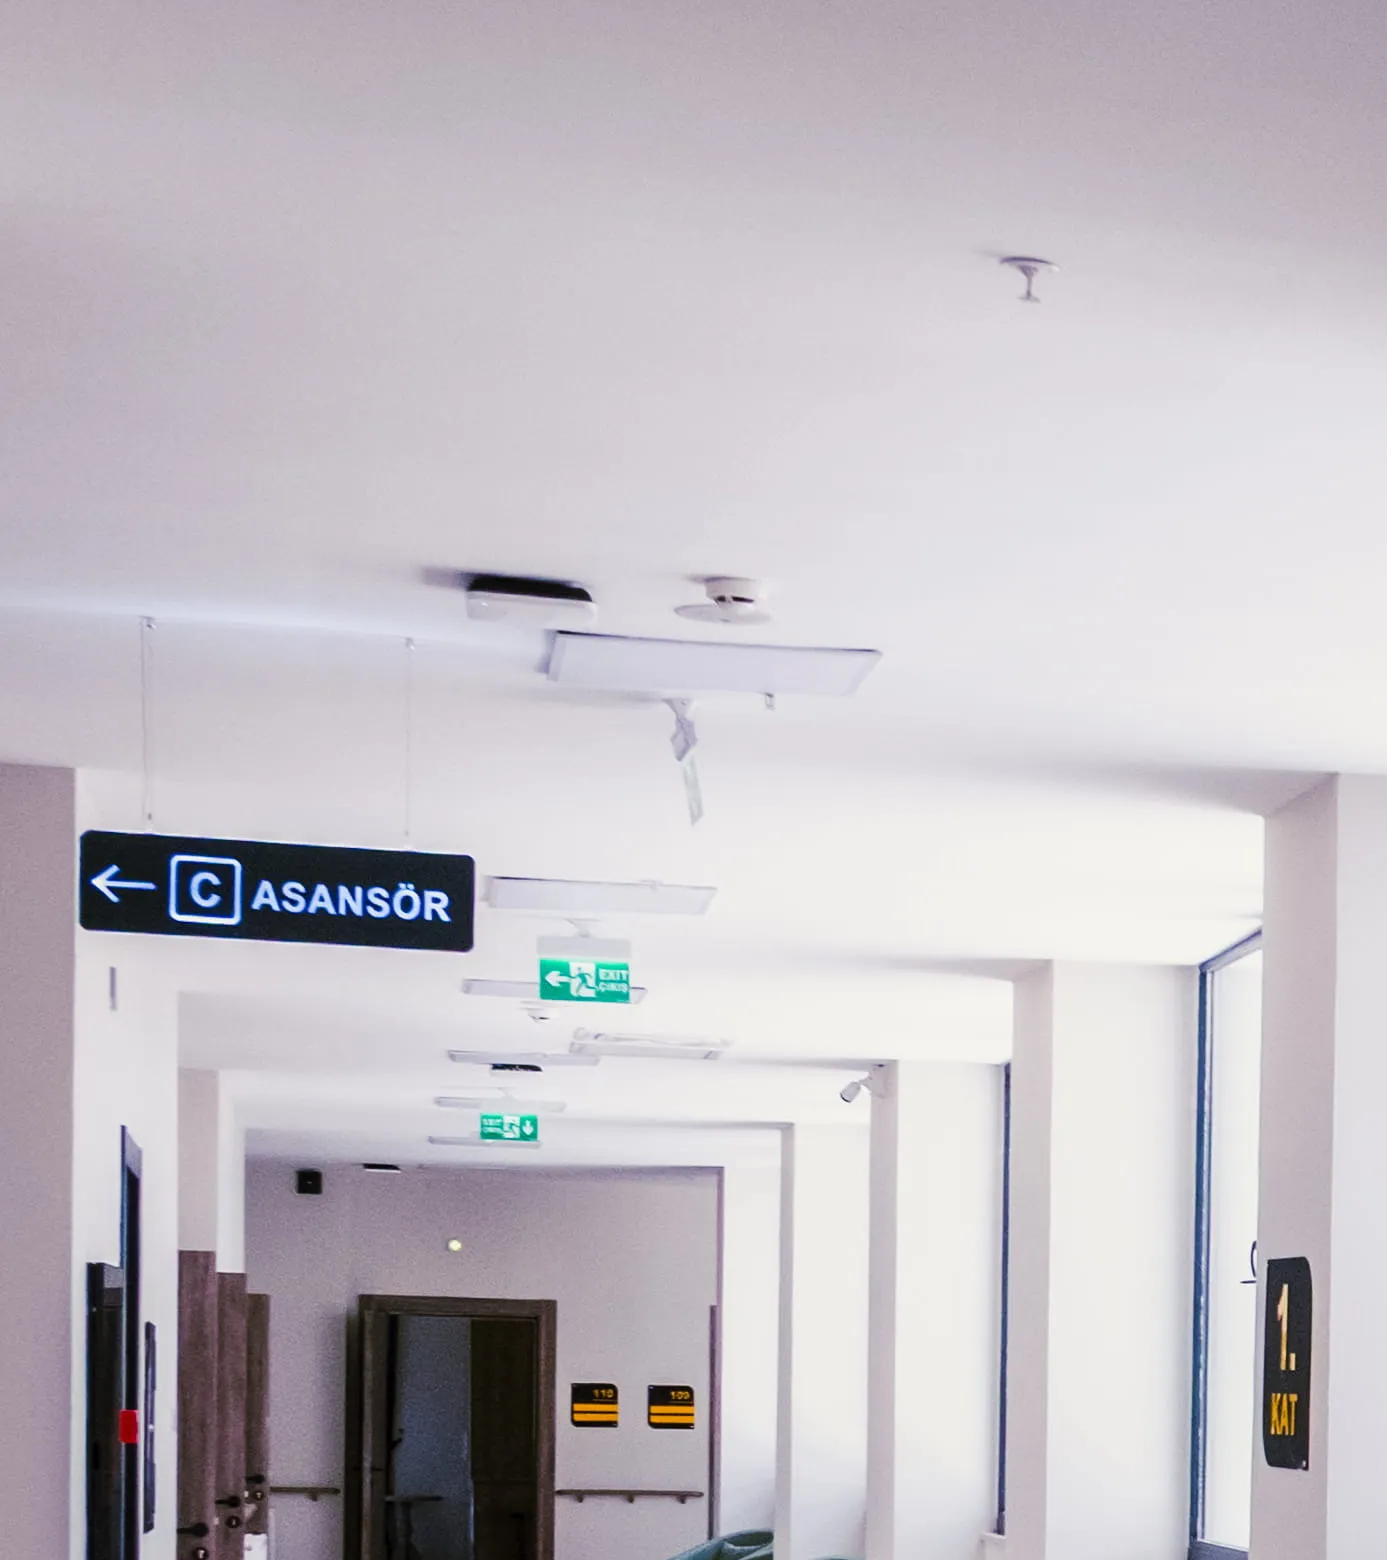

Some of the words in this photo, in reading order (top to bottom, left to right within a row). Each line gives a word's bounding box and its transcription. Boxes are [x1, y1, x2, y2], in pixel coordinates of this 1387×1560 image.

[190, 872, 222, 908] C
[251, 879, 452, 923] ASANSÖR
[1277, 1283, 1296, 1371] 1.
[1270, 1393, 1298, 1436] KAT
